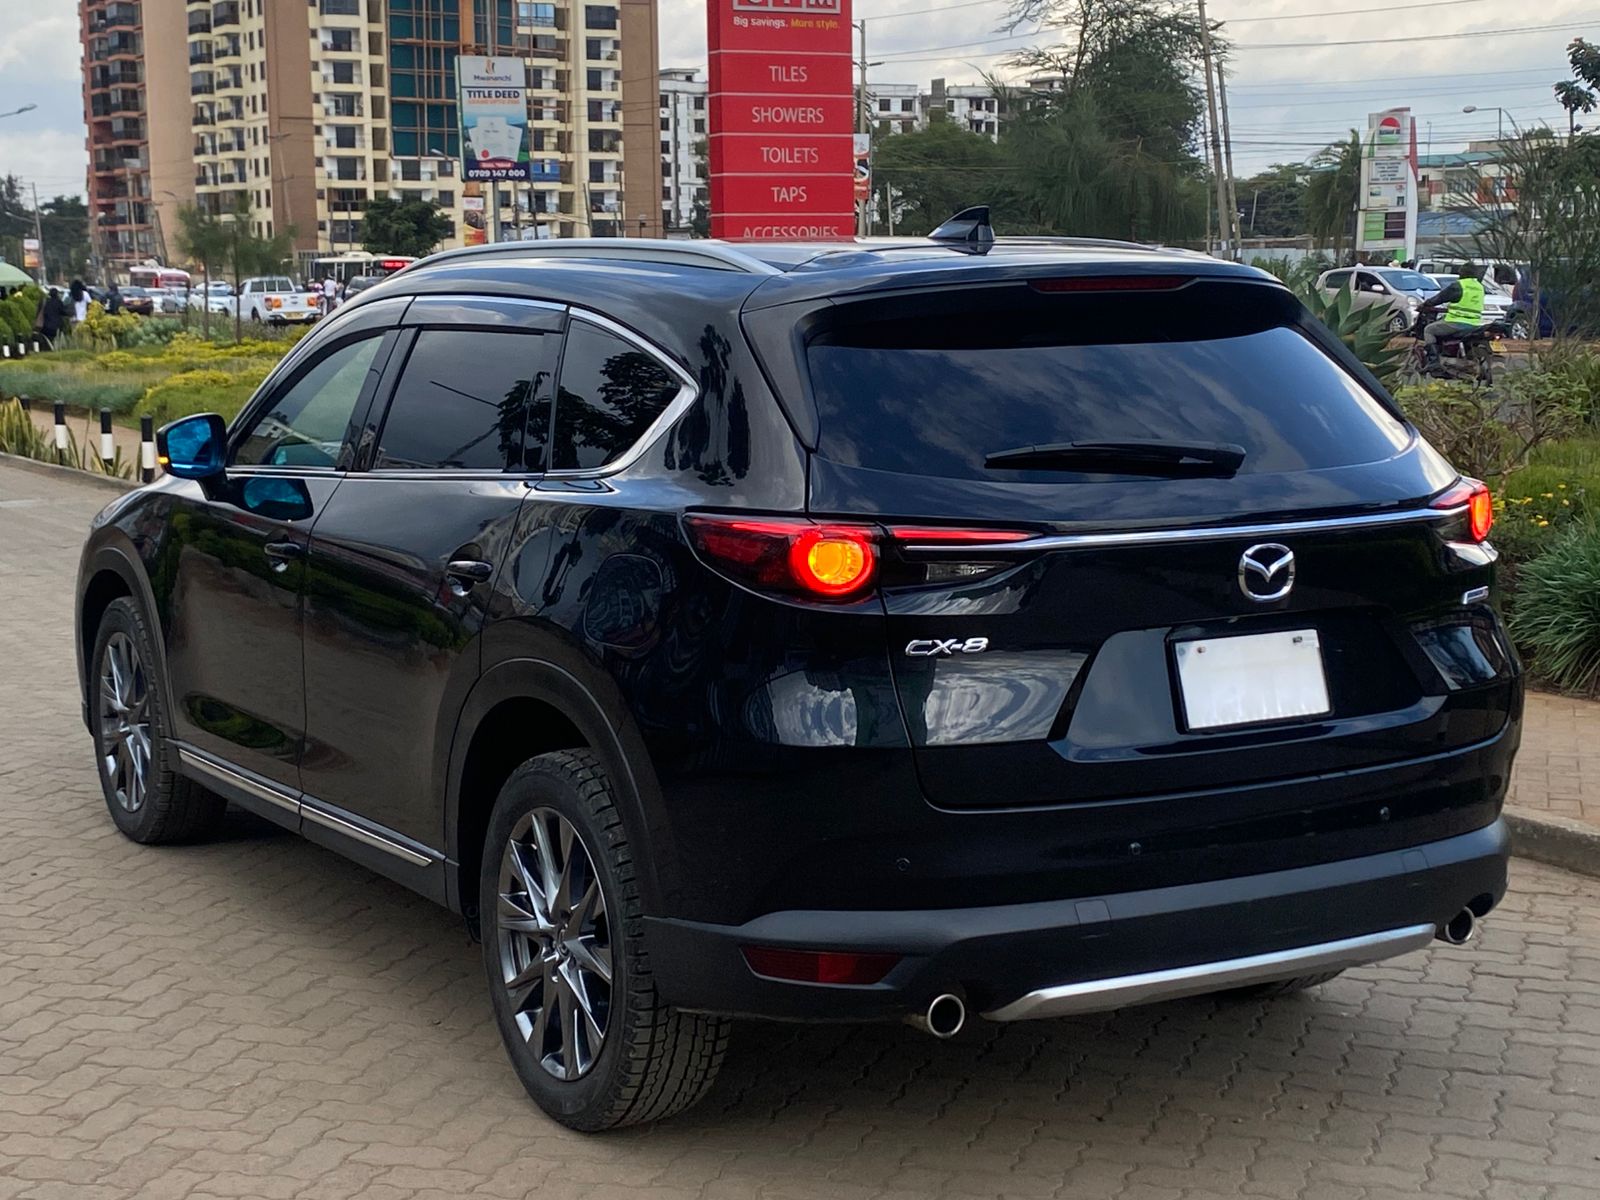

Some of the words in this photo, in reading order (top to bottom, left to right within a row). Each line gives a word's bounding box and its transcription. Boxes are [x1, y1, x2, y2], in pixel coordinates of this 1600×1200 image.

[733, 16, 748, 28] Big
[751, 17, 788, 29] savings.
[791, 18, 814, 28] More
[816, 19, 840, 31] style.
[768, 65, 808, 82] TILES
[467, 90, 492, 98] TITLE
[495, 90, 520, 98] DEED
[751, 106, 824, 123] SHOWERS
[760, 146, 819, 163] TOILETS
[770, 186, 808, 202] TAPS
[905, 637, 989, 657] CX-8
